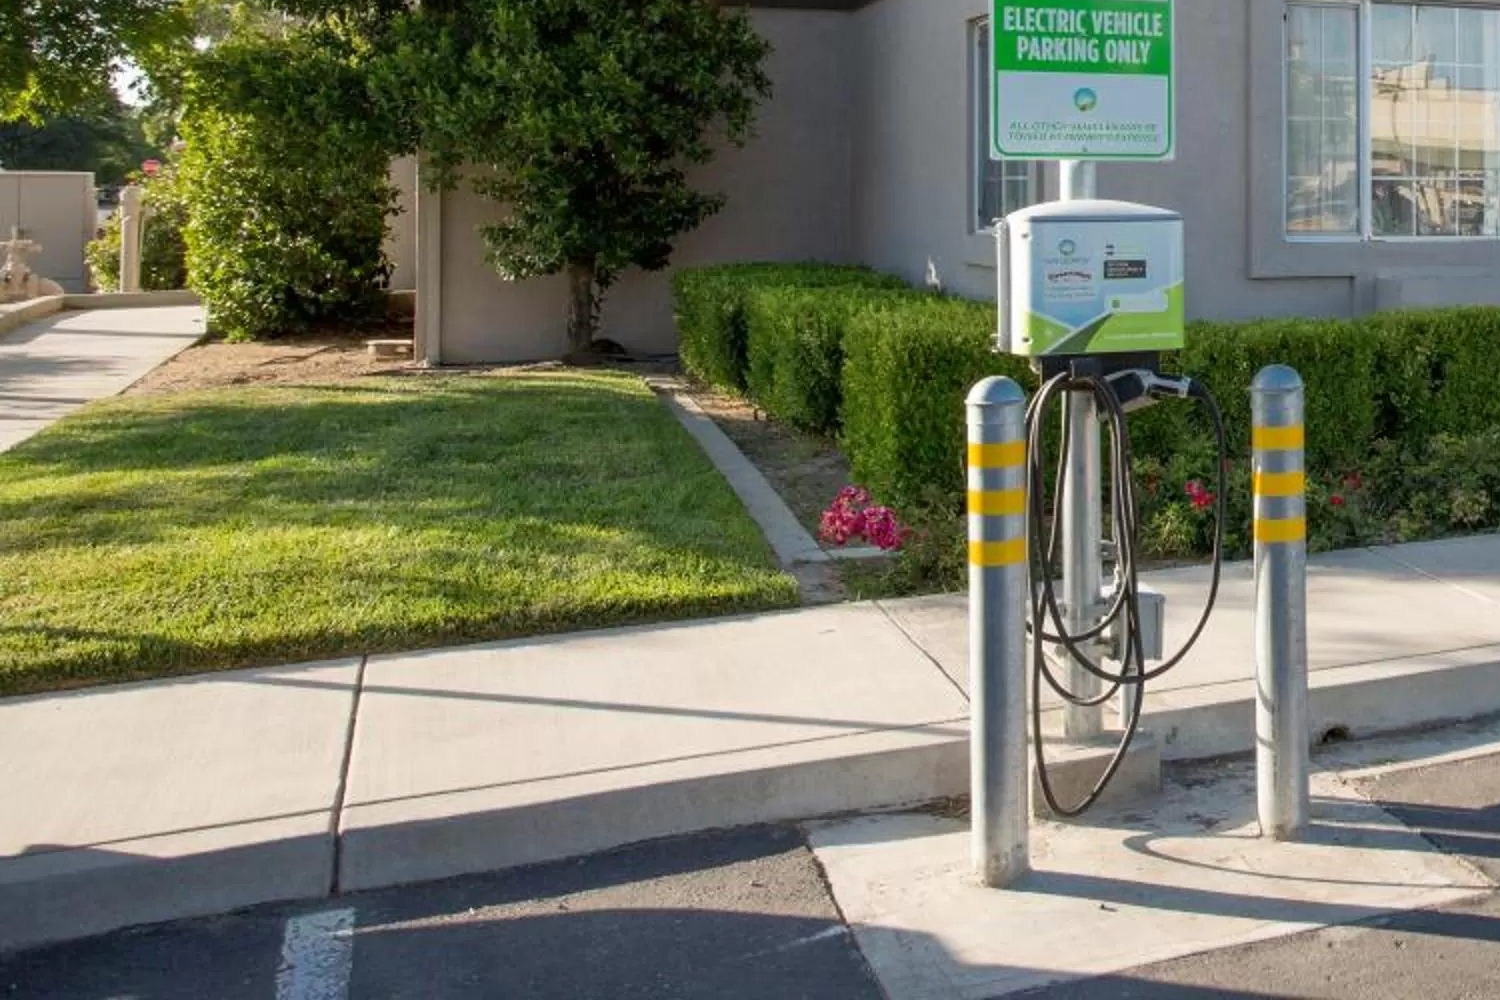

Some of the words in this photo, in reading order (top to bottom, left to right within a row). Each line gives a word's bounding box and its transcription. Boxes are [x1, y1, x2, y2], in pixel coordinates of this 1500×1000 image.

[1003, 6, 1088, 33] ELECTRIC
[1092, 10, 1164, 37] VEHICLE
[1016, 35, 1100, 63] PARKING
[1104, 39, 1153, 65] ONLY
